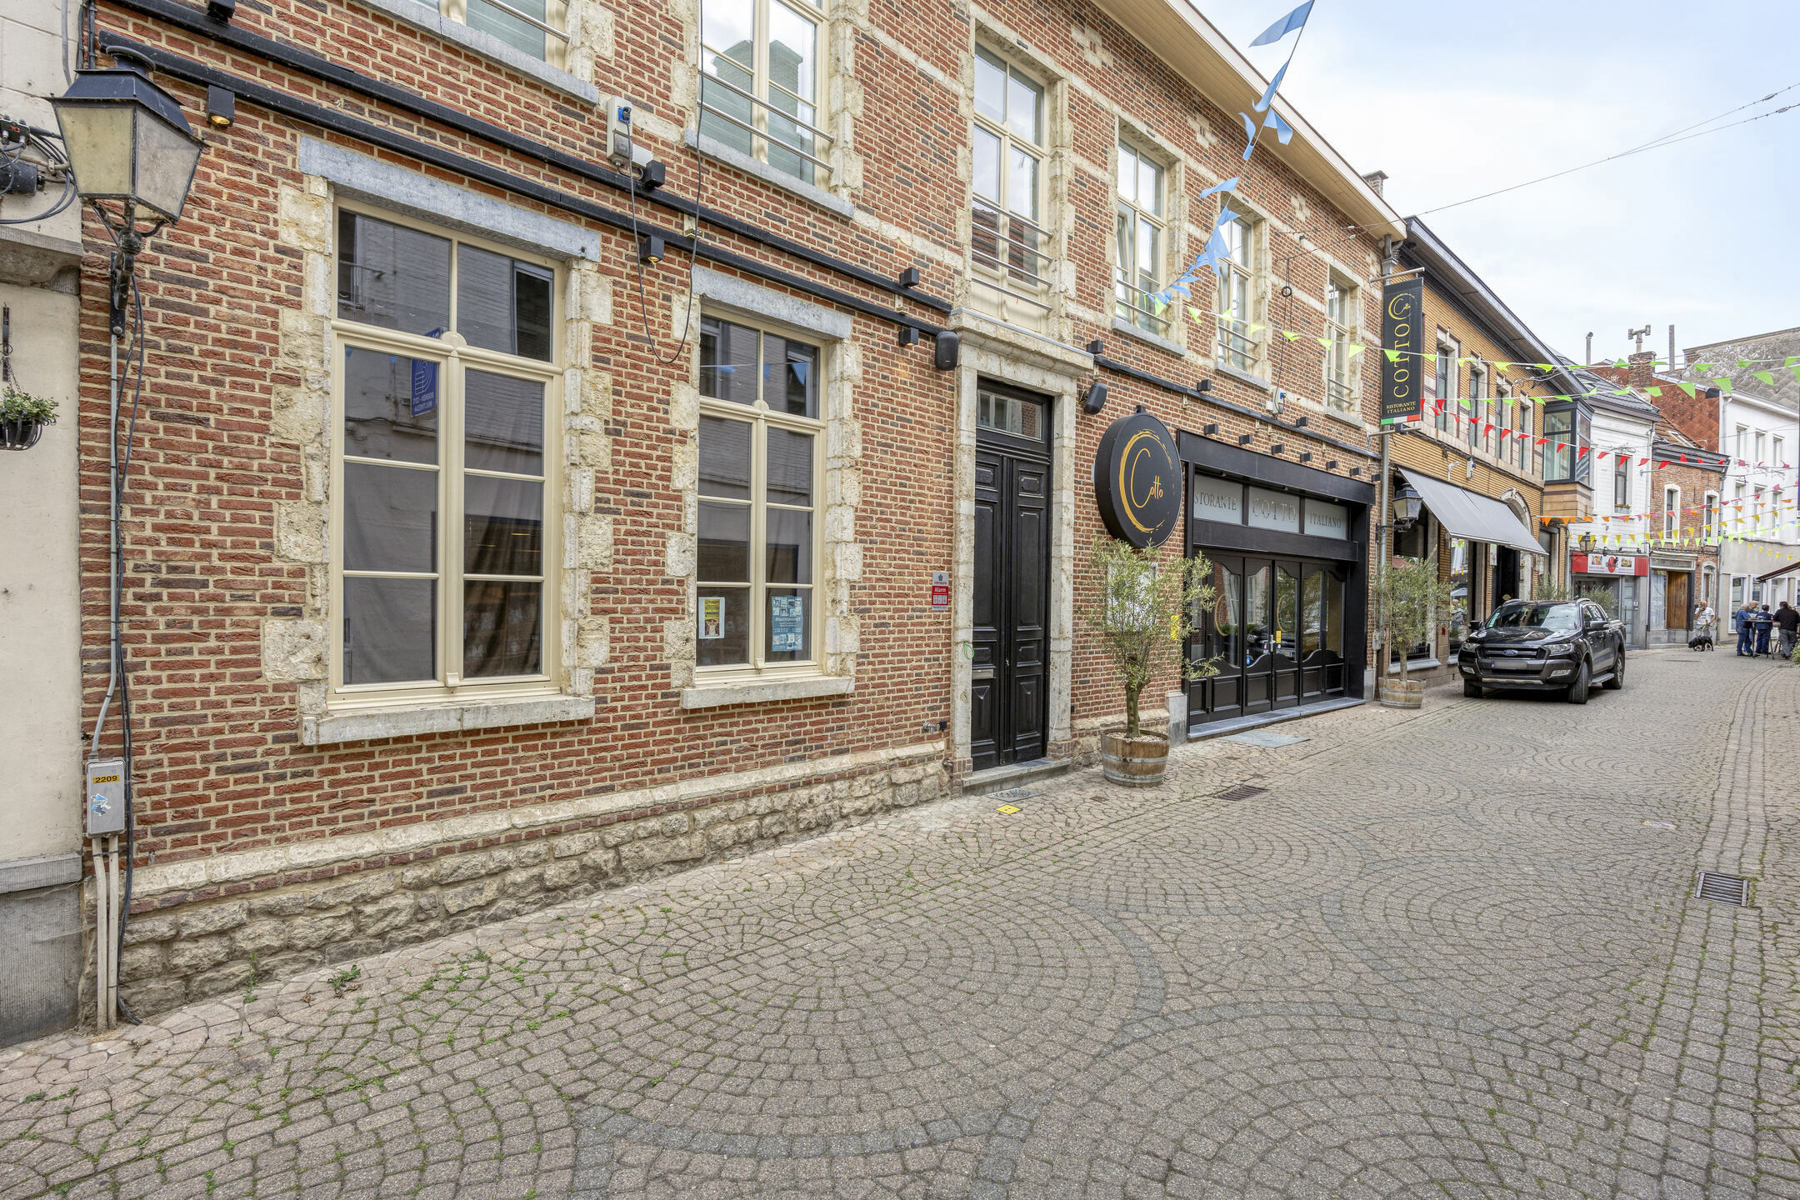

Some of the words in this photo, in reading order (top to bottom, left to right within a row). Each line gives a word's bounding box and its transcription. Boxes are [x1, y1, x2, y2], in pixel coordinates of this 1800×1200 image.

[1393, 323, 1410, 398] COTTO
[1387, 406, 1415, 414] ITALIANO
[1130, 448, 1164, 508] Cotto
[95, 775, 118, 783] 2209
